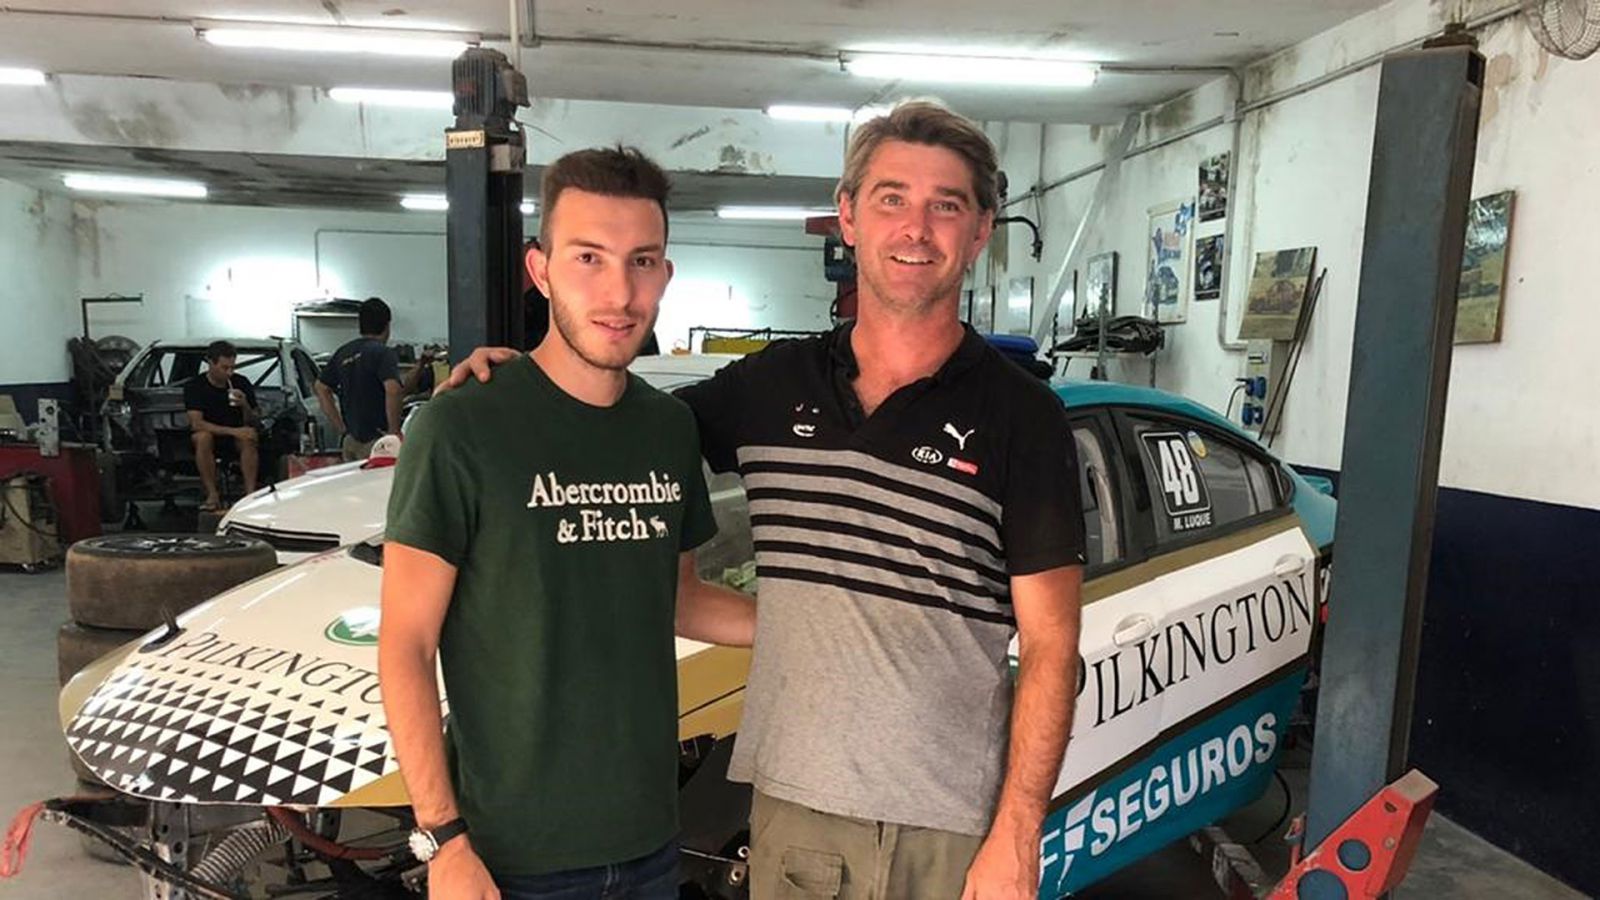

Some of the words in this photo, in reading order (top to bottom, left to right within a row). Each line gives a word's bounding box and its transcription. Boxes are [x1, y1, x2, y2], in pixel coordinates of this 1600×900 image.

[914, 448, 939, 463] KIA
[1158, 439, 1200, 506] 48
[527, 470, 682, 508] Abercrombie
[556, 518, 578, 544] &
[580, 507, 650, 542] Fitch
[1185, 512, 1211, 528] LUQUE
[1091, 712, 1276, 856] SEGUROS
